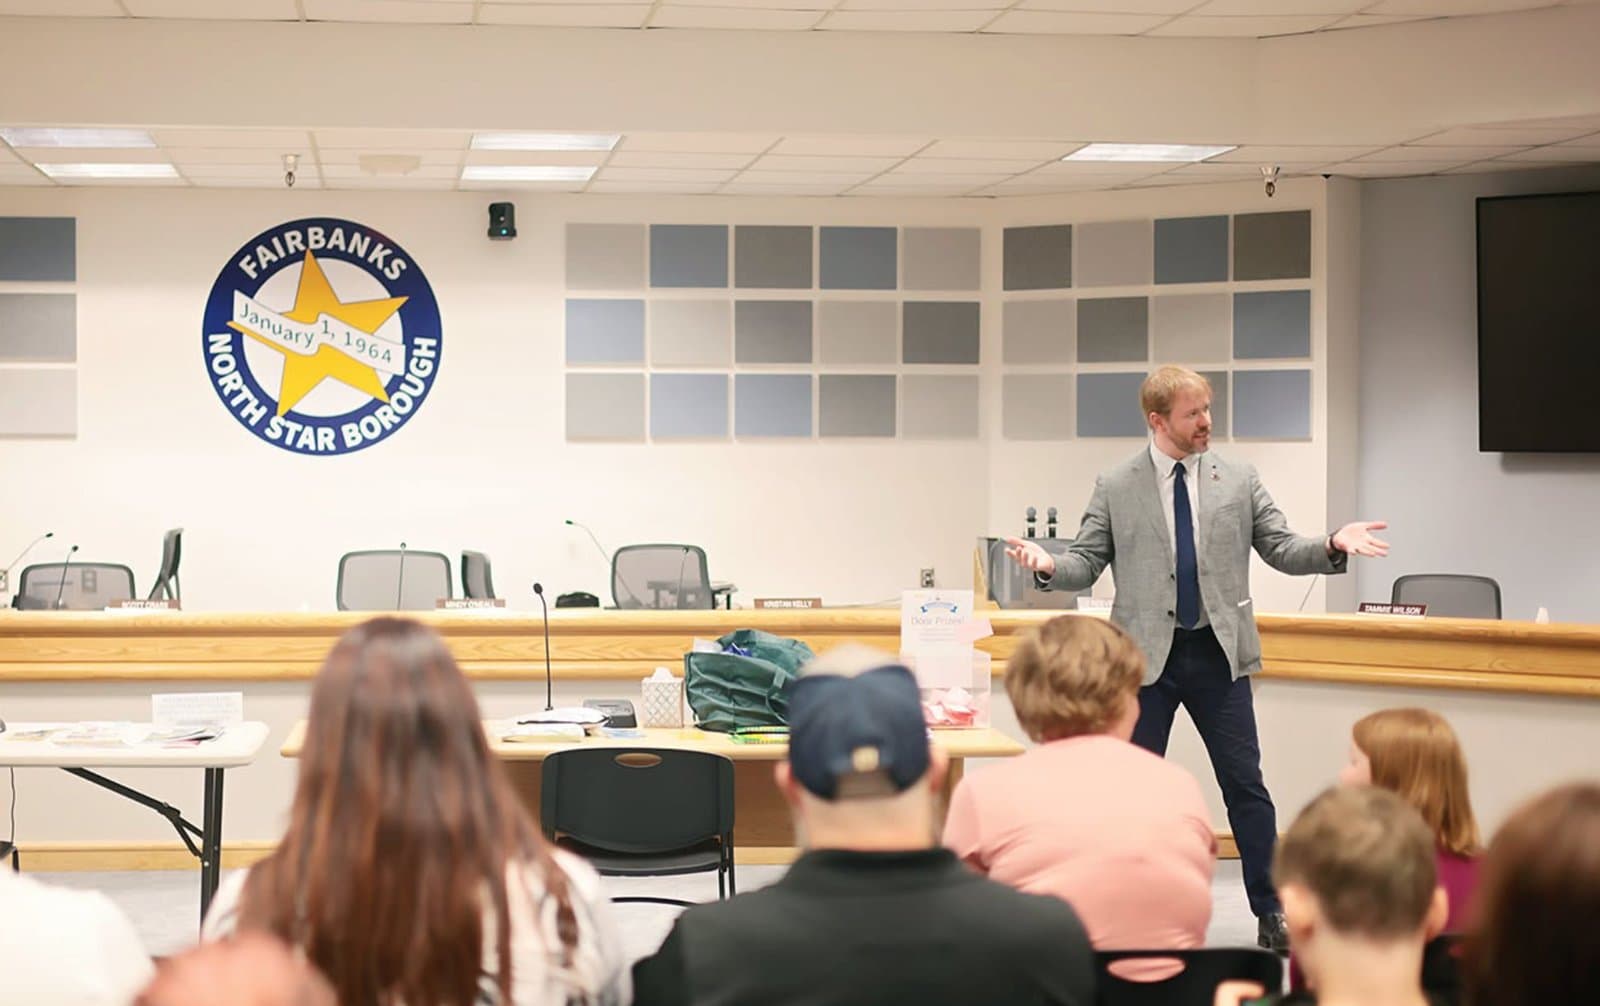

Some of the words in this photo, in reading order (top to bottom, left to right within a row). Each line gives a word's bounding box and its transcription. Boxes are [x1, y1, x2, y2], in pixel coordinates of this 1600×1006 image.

[239, 226, 407, 280] FAIRBANKS
[240, 304, 314, 347] January
[320, 320, 335, 339] 1,
[344, 331, 392, 363] 1964
[208, 333, 268, 426] NORTH
[265, 416, 336, 451] STAR
[341, 337, 437, 448] BOROUGH
[1393, 606, 1421, 615] WILSON
